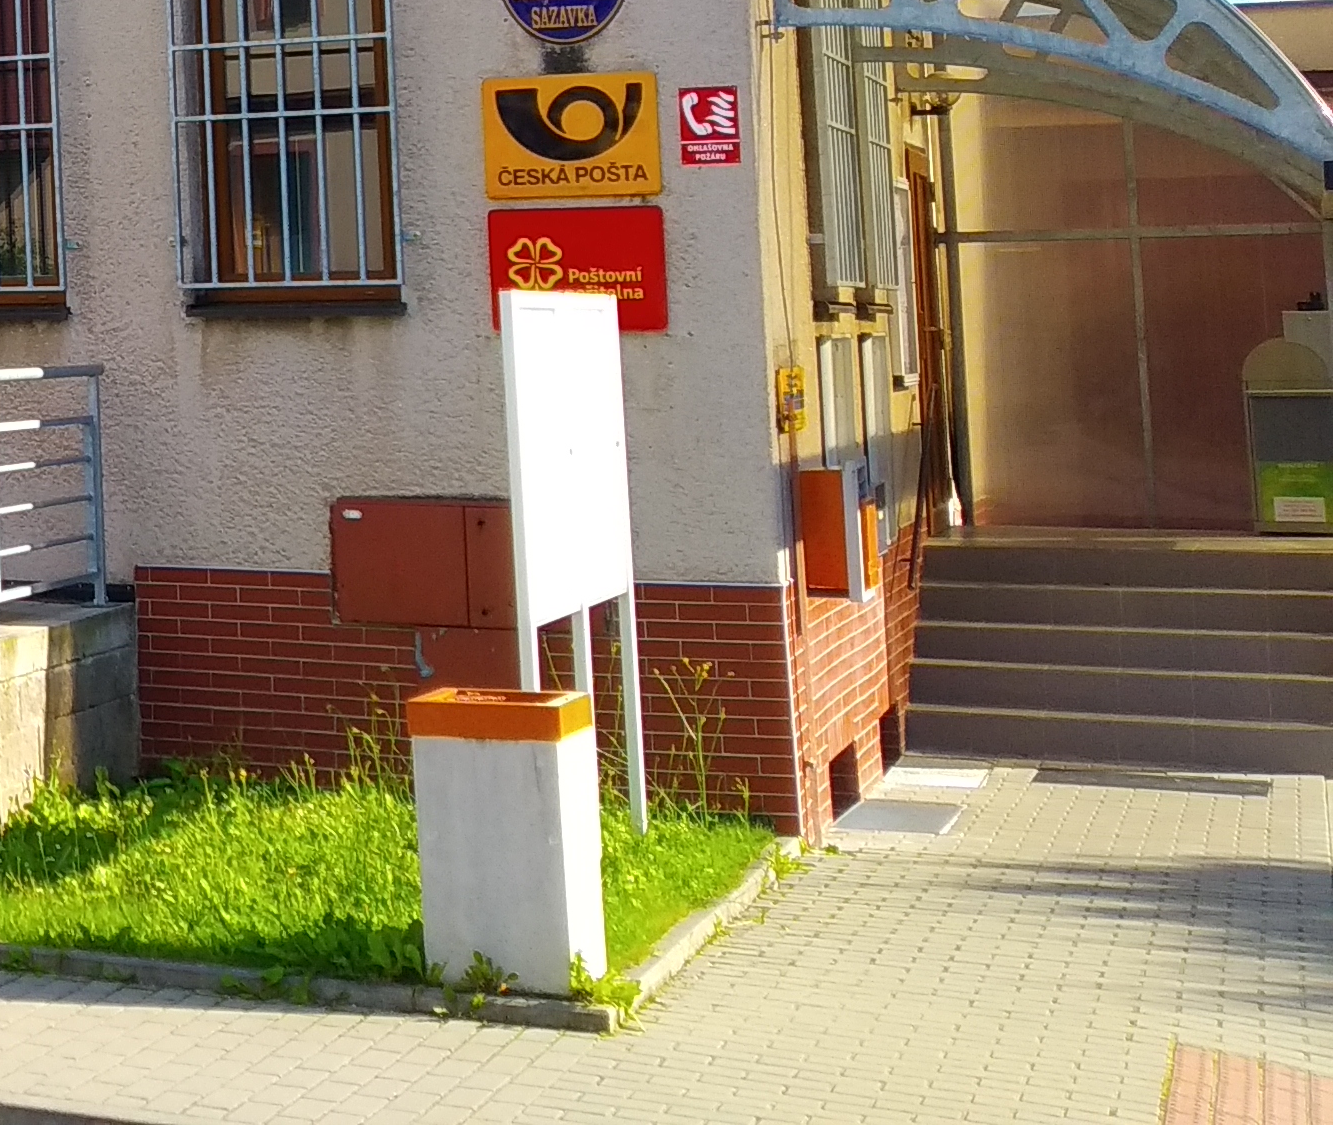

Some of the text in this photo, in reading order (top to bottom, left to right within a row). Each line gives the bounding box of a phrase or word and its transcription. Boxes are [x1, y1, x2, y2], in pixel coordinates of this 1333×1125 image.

[531, 0, 598, 29] SÁZAVKA
[498, 161, 649, 187] ČESKÁ POŠTA
[568, 266, 643, 284] Poštovní
